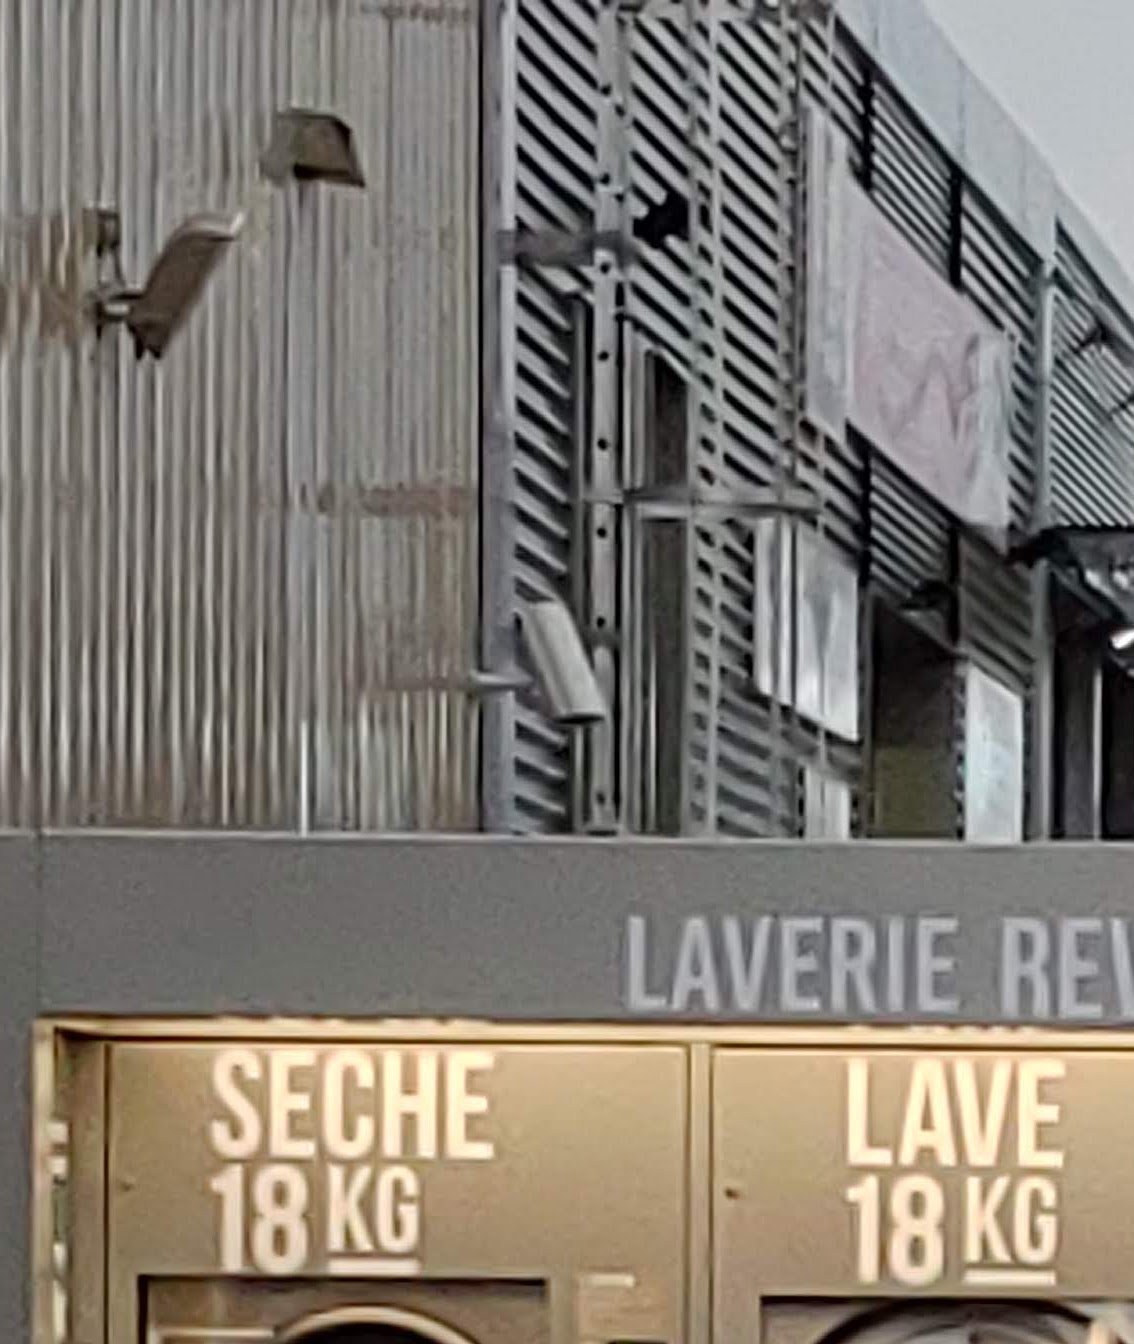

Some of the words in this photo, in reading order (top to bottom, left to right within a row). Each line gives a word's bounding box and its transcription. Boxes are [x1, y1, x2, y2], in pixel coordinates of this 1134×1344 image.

[624, 914, 960, 1016] LAVERIE
[209, 1049, 496, 1162] SECHE
[845, 1058, 1066, 1170] LAVE
[208, 1162, 311, 1274] 18
[327, 1165, 420, 1254] KG
[845, 1175, 945, 1287] 18
[963, 1175, 1059, 1267] KG
